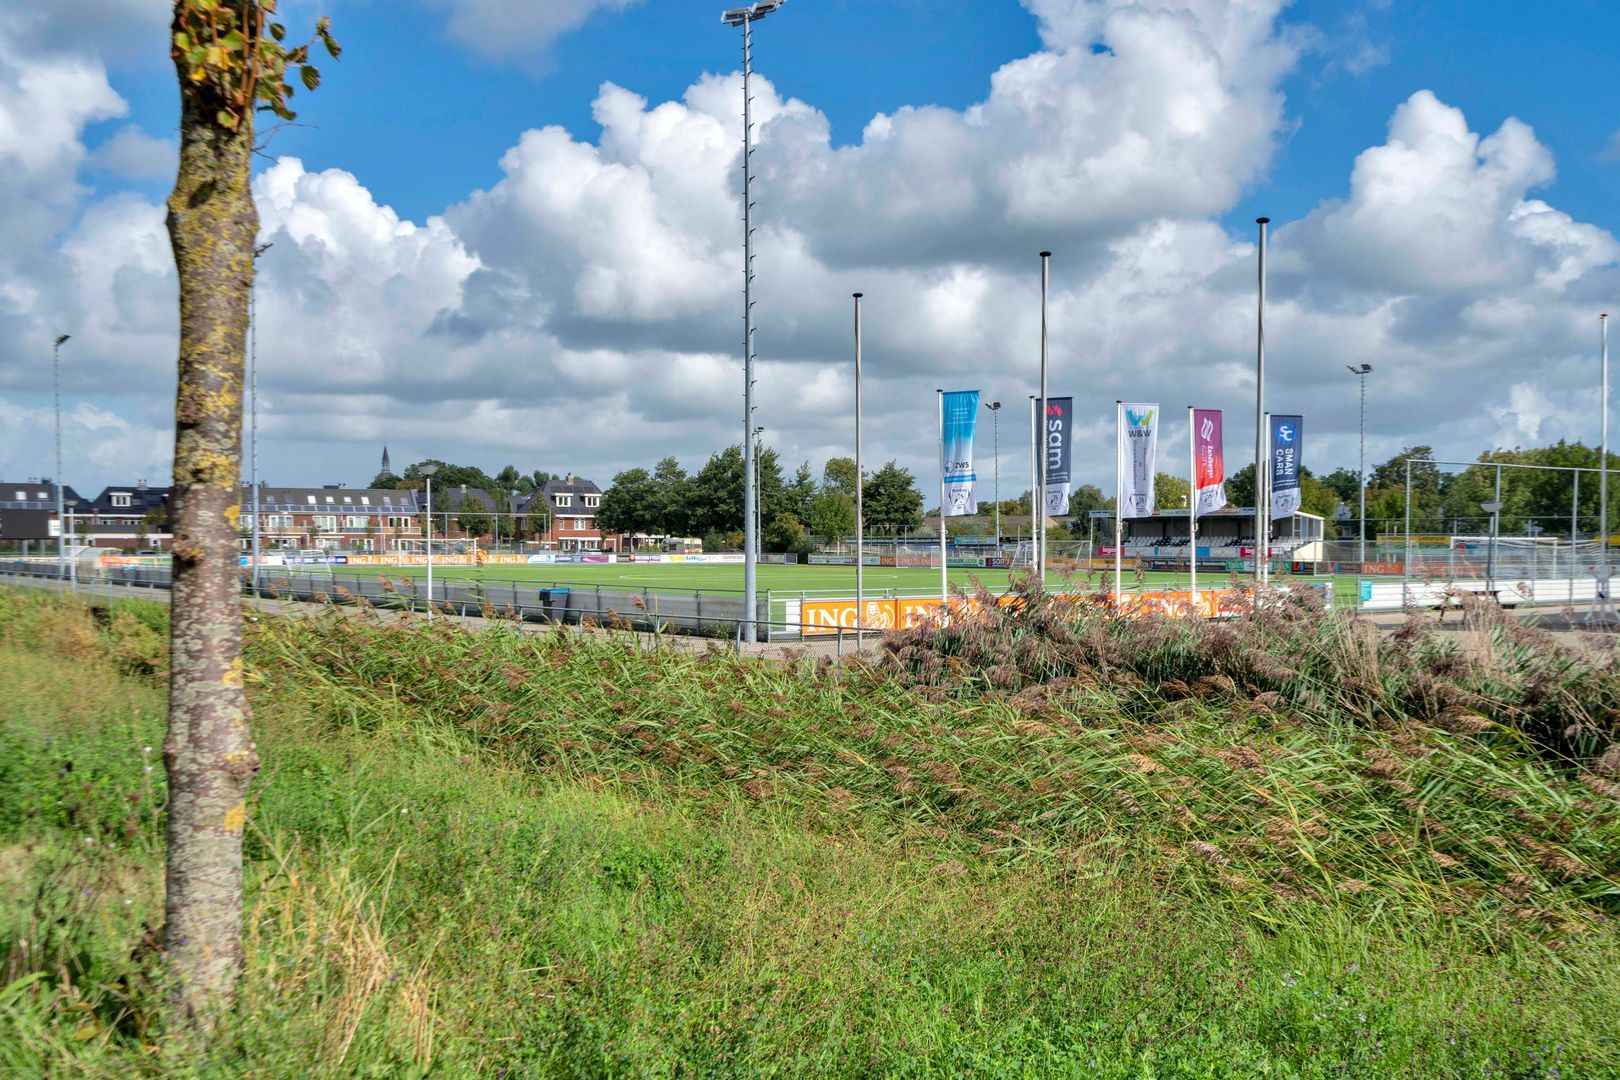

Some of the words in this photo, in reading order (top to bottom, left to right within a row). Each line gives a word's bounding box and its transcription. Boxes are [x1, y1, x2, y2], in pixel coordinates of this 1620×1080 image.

[1048, 419, 1063, 470] sam
[1128, 430, 1152, 438] W&W
[954, 461, 970, 469] ZWS
[1275, 449, 1284, 476] CARS
[1284, 448, 1294, 475] SMAN
[1364, 564, 1385, 574] ING
[806, 608, 859, 632] ING
